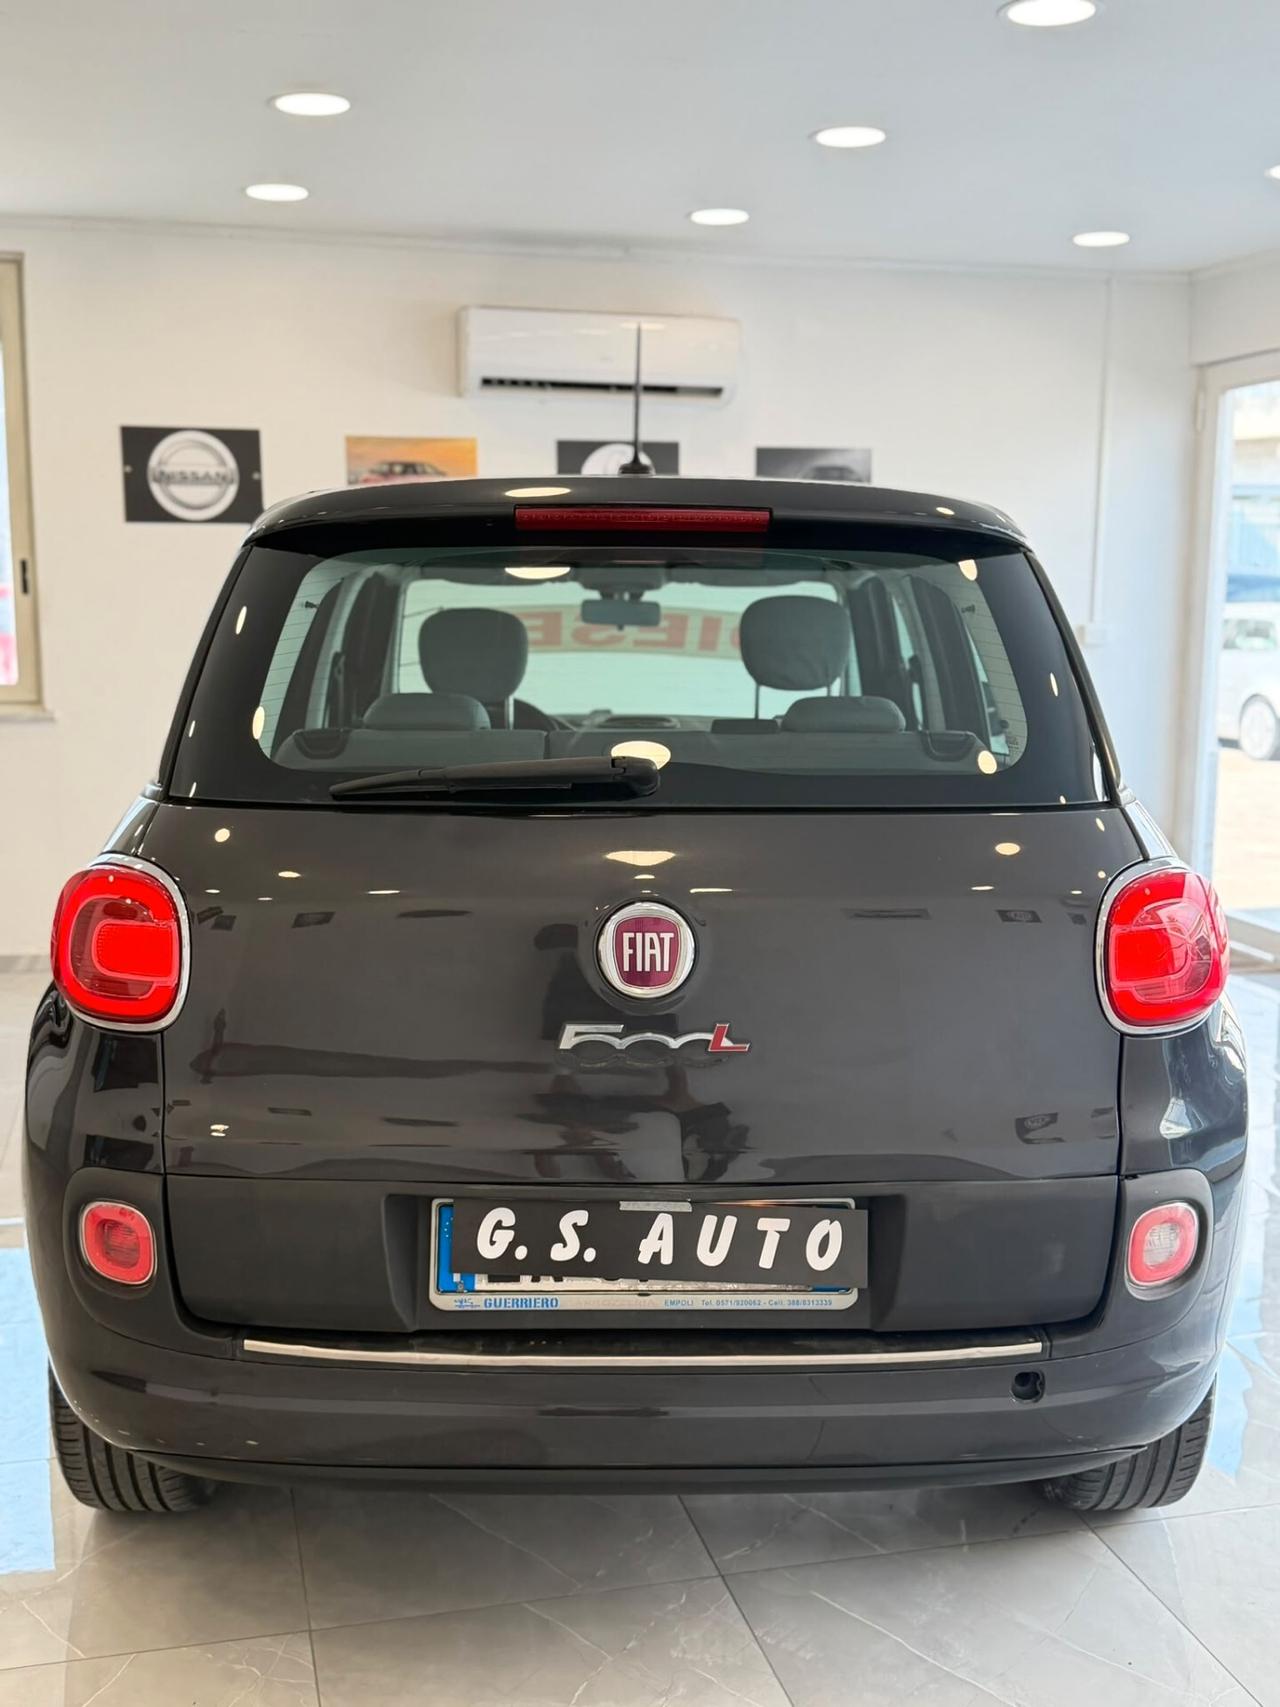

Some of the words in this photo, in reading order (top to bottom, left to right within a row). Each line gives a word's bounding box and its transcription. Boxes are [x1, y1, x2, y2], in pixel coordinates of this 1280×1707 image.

[158, 469, 228, 481] NISSAN
[622, 932, 675, 972] FIAT
[558, 1023, 751, 1052] 500L
[477, 1207, 529, 1261] G.
[550, 1210, 597, 1263] S.
[638, 1213, 843, 1271] AUTO
[484, 1297, 559, 1309] GUERRIERO
[664, 1299, 694, 1307] EMPOLI
